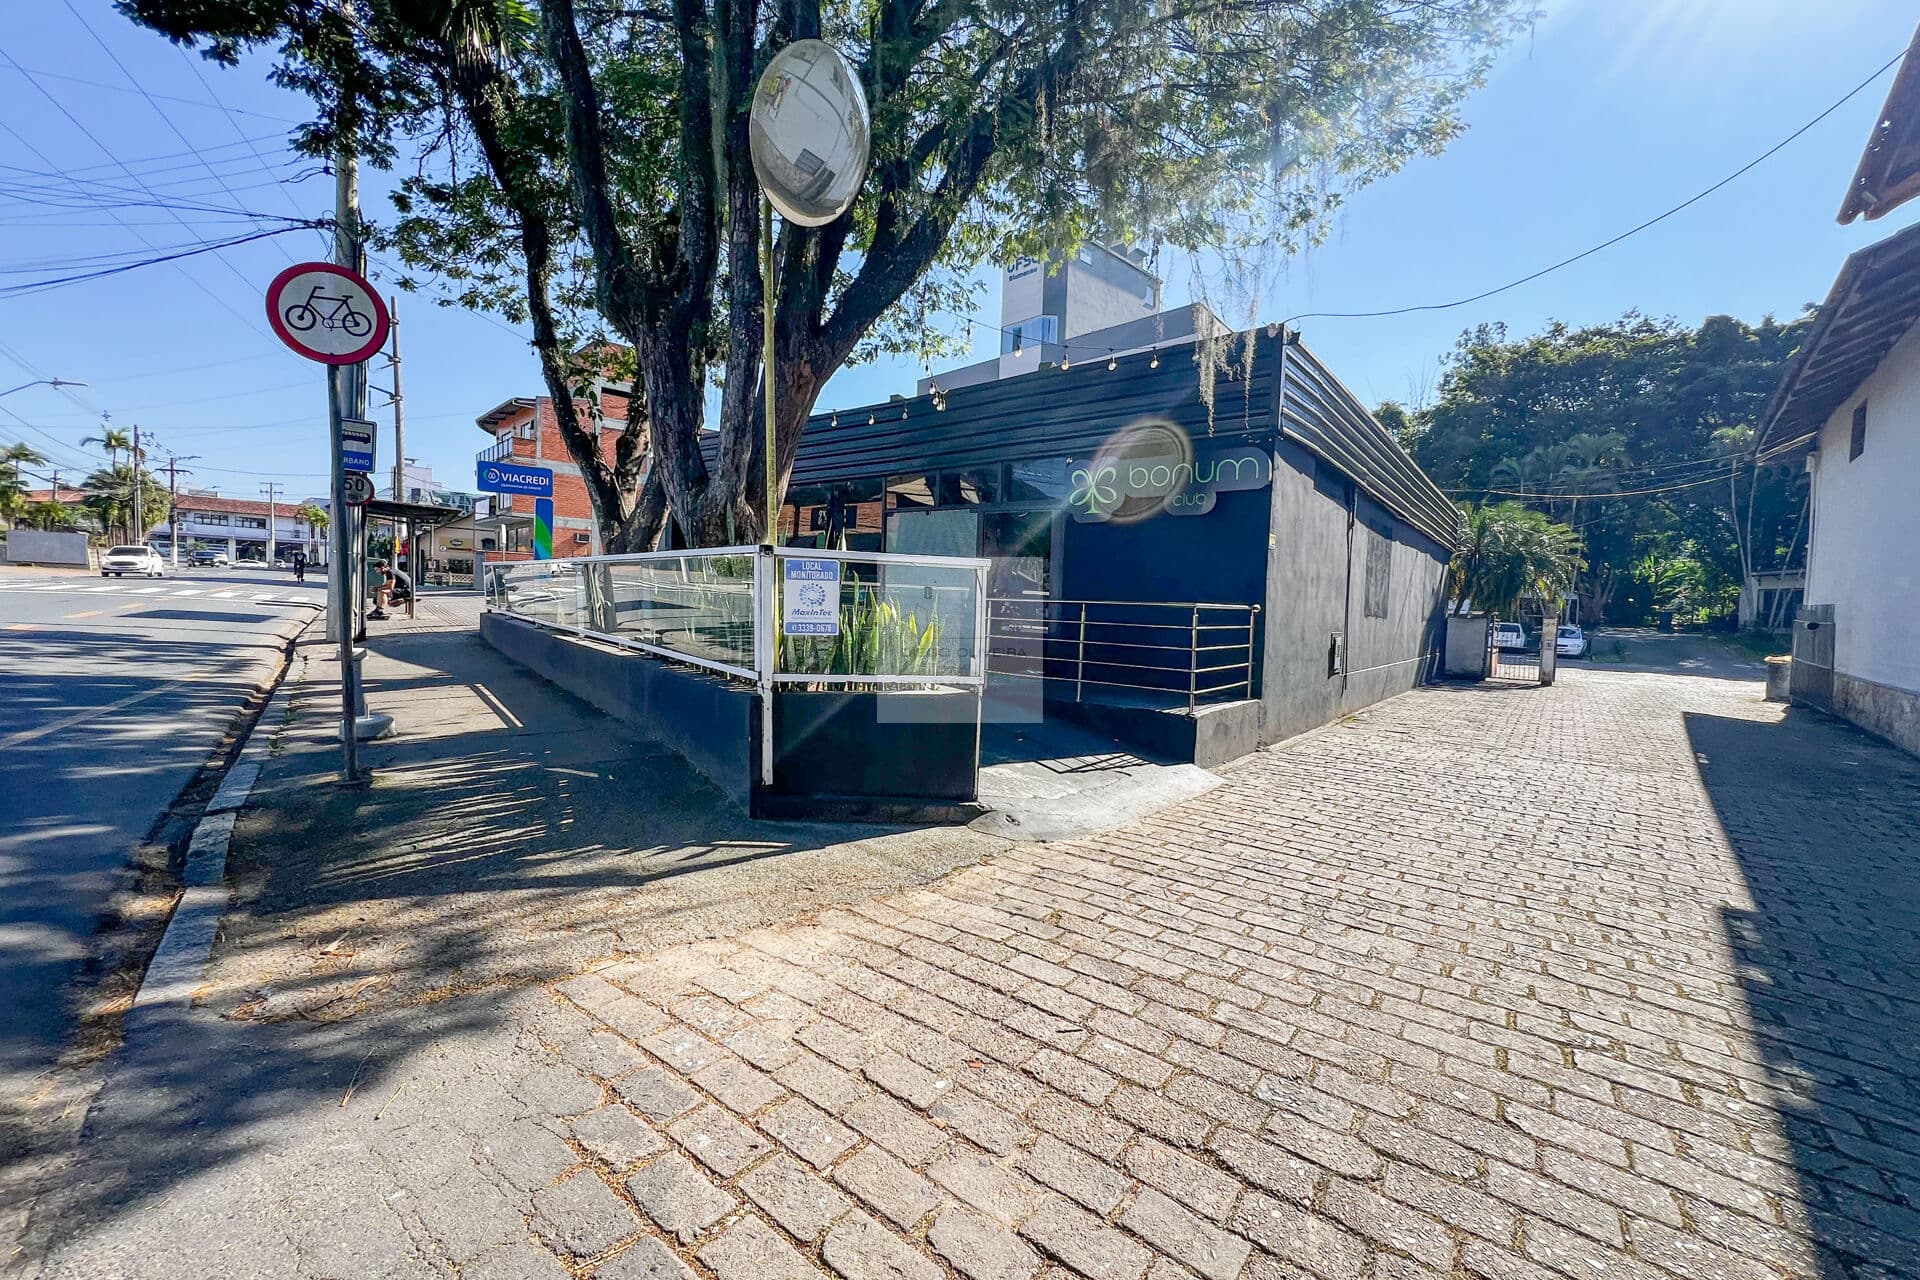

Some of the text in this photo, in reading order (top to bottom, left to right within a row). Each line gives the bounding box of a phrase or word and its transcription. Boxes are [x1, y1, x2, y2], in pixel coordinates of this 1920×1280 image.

[343, 457, 370, 466] RBANO
[1129, 457, 1259, 489] bonum
[501, 473, 549, 486] VIACREDI
[1172, 492, 1207, 507] club
[802, 561, 823, 570] LOCAL
[791, 570, 833, 580] MONITORADO
